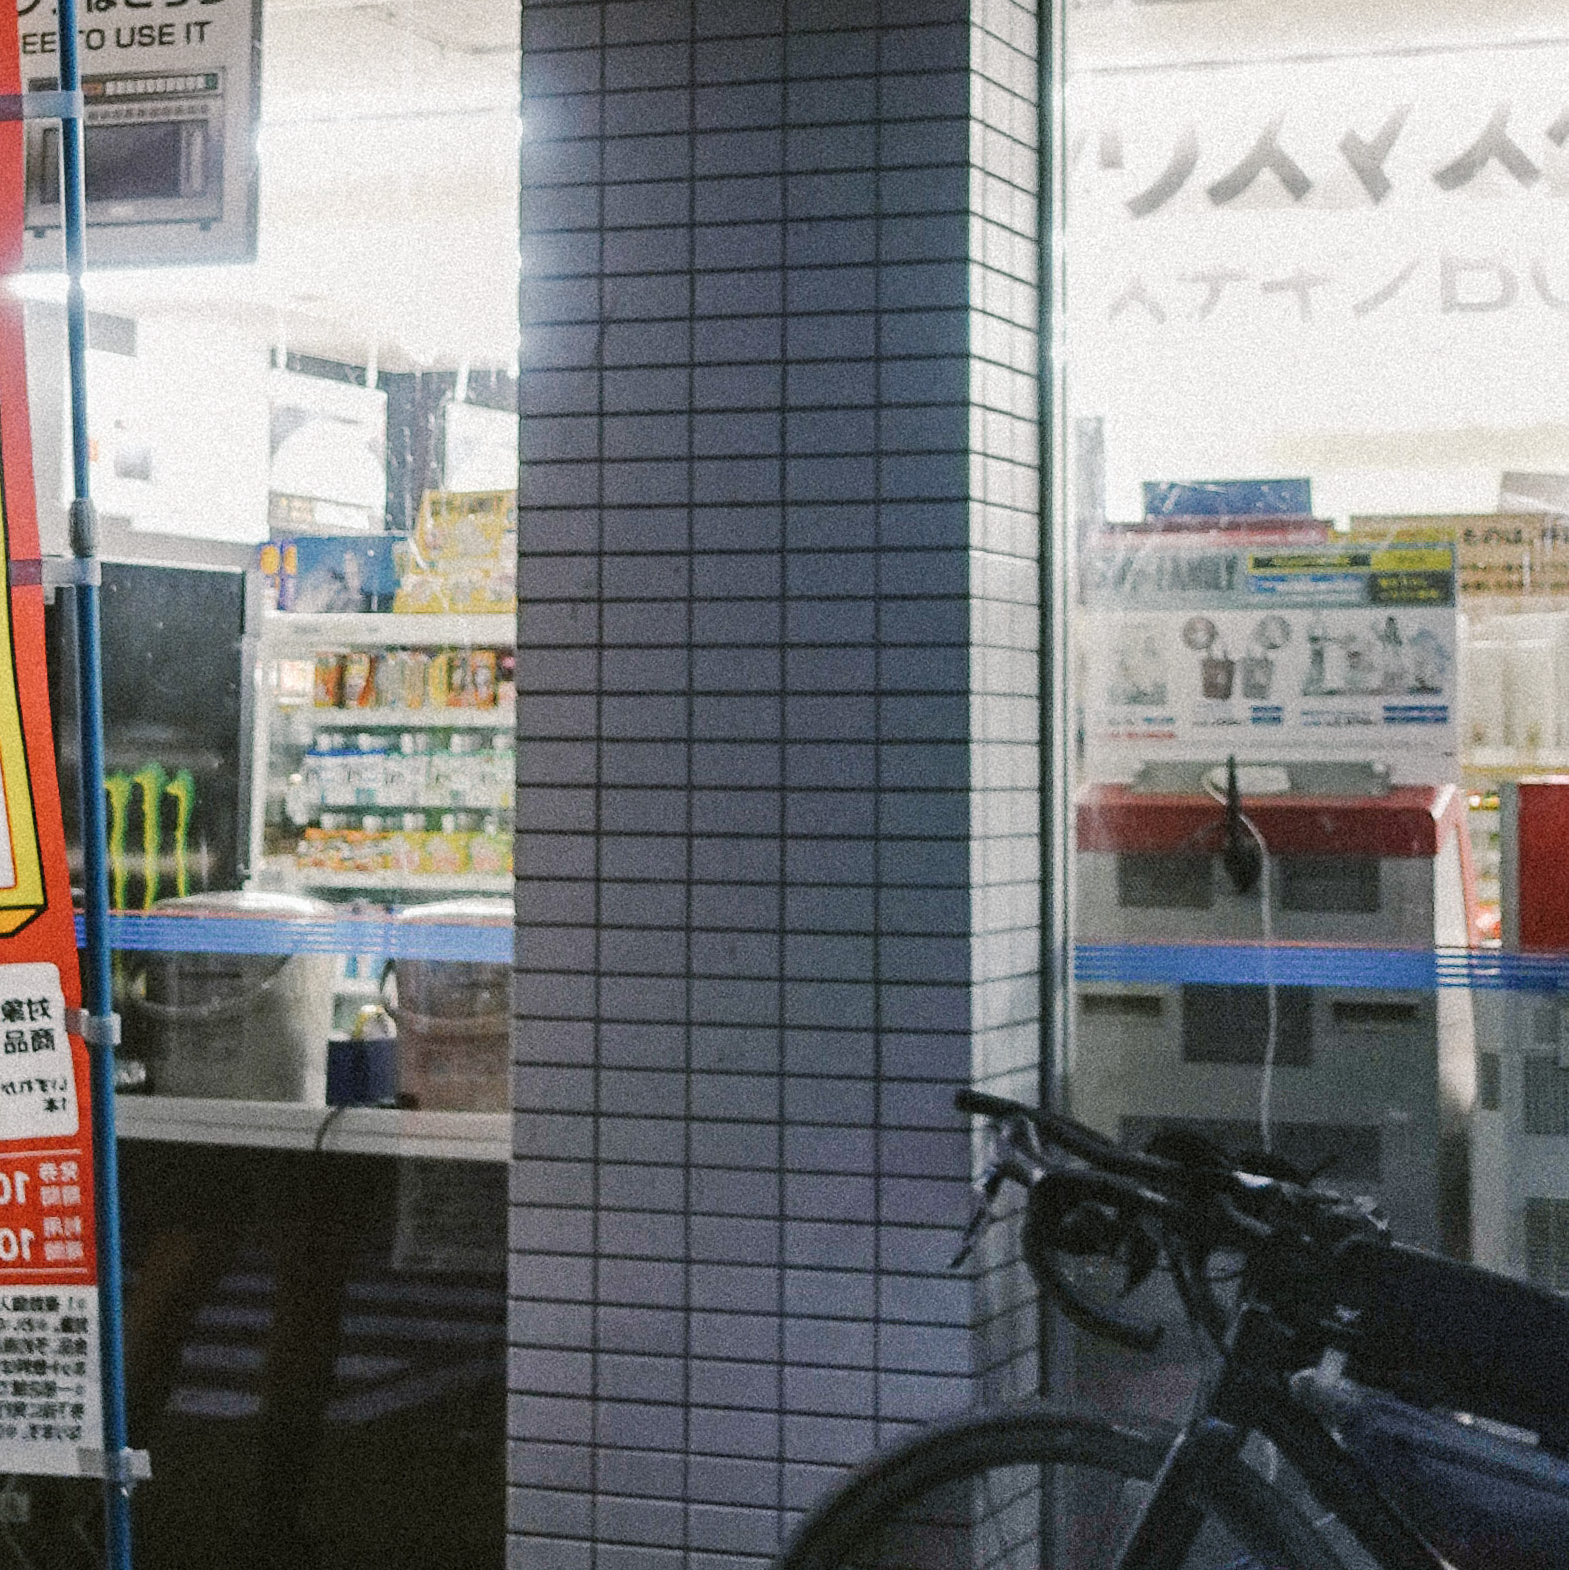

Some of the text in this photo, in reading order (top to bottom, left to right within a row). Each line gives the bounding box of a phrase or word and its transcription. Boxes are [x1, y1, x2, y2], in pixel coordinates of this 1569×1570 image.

[22, 31, 57, 55] EE
[116, 23, 175, 49] USE
[185, 20, 212, 44] IT
